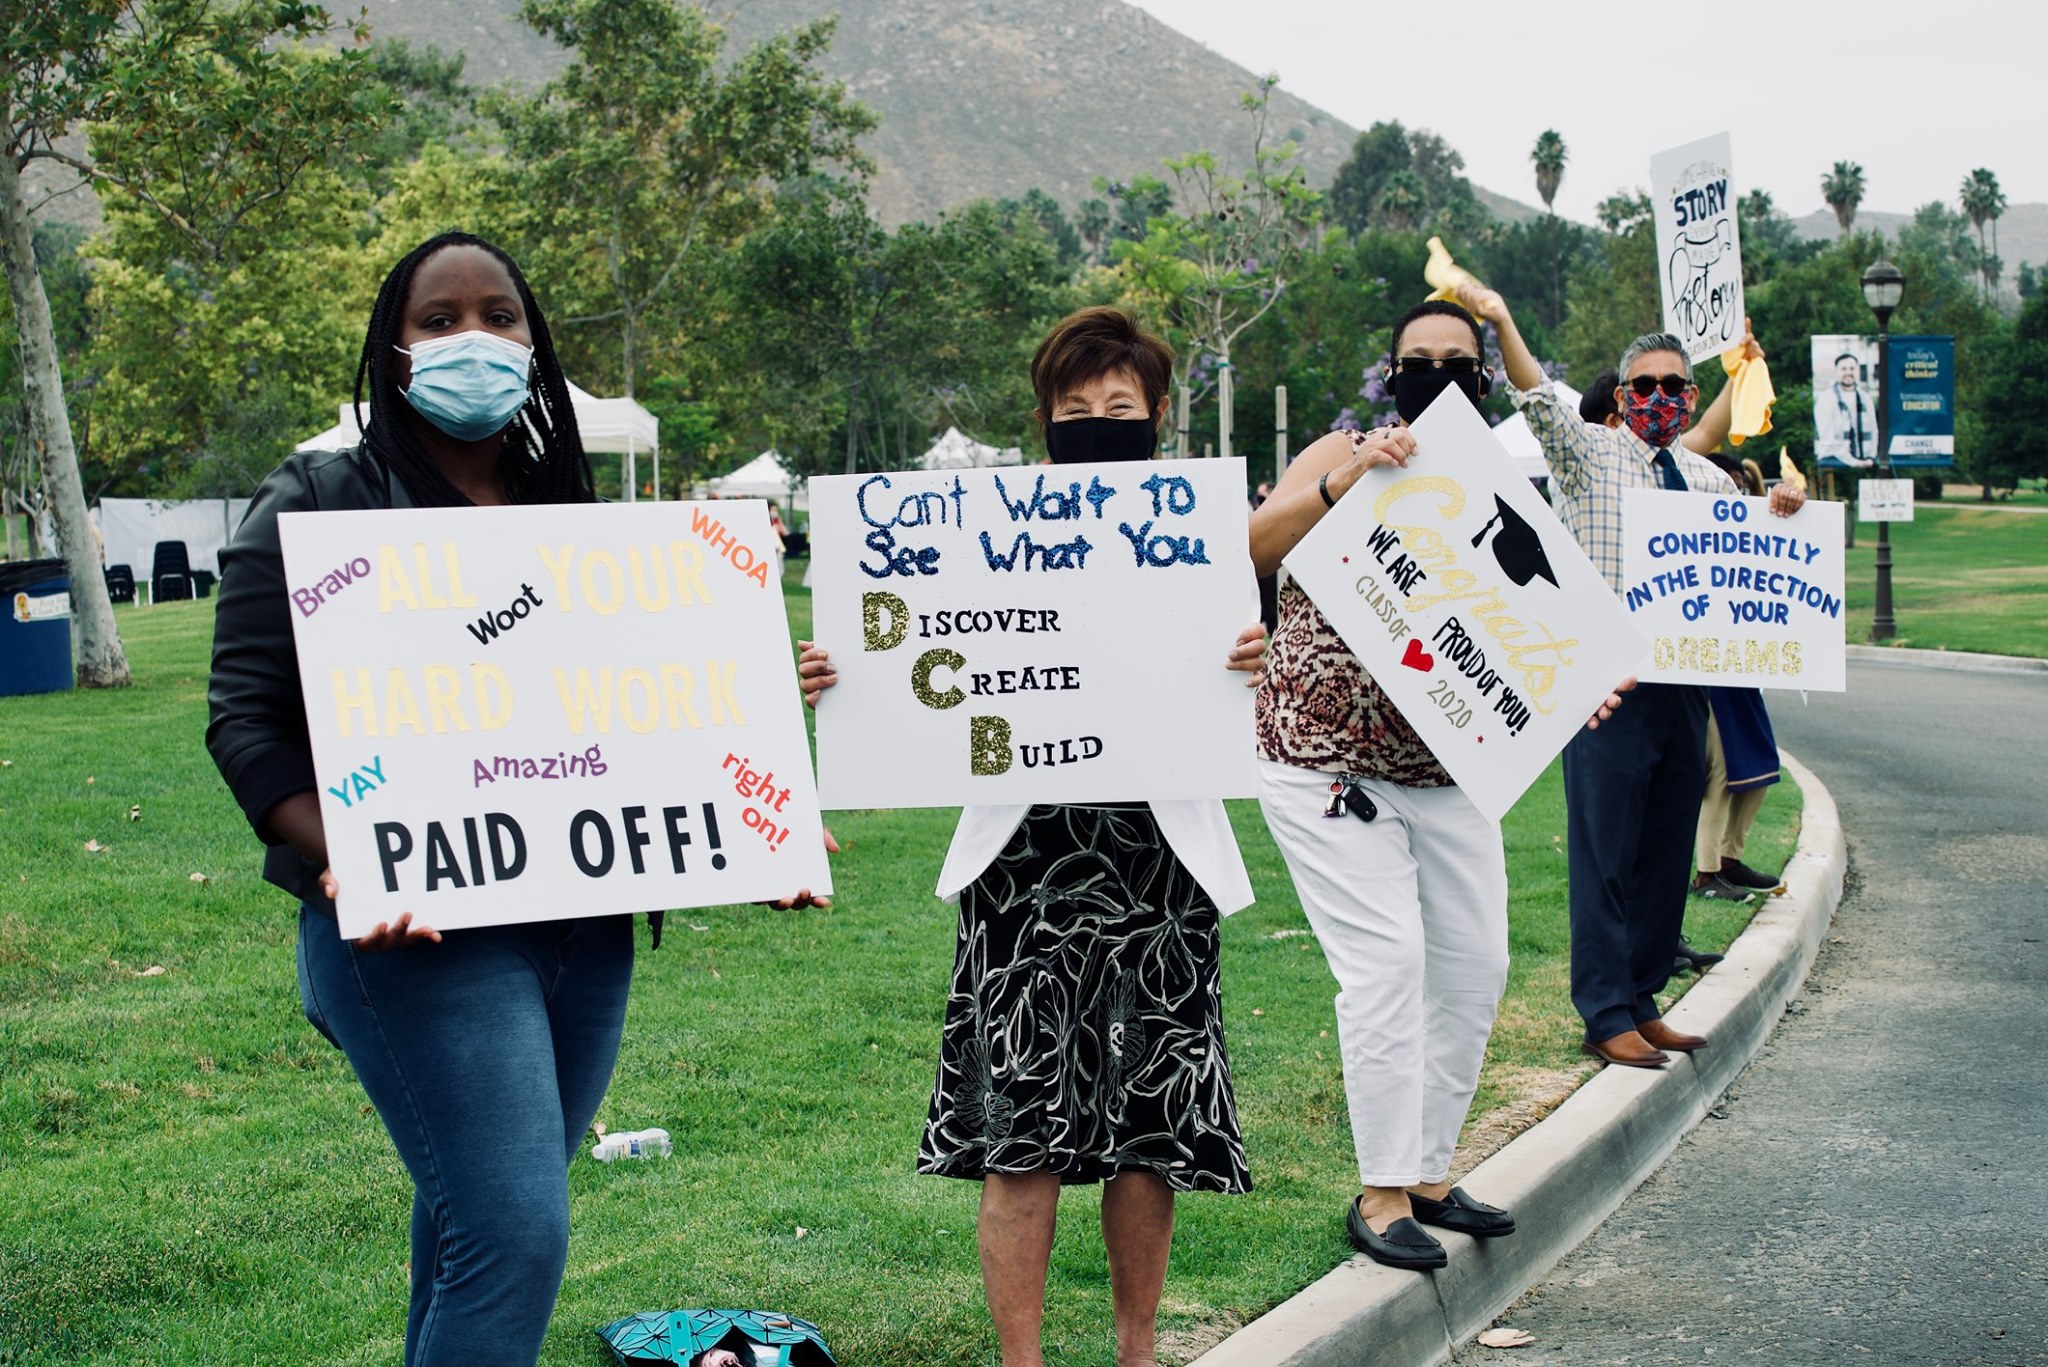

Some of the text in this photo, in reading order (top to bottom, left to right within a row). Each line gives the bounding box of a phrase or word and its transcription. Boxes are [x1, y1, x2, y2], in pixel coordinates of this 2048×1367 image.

[1674, 179, 1728, 228] STORY
[1905, 360, 1939, 369] critical
[1905, 369, 1939, 378] thinker
[1903, 401, 1940, 410] EDUCATOR
[1905, 439, 1933, 448] CHANGE
[994, 474, 1116, 521] Wait
[1712, 499, 1748, 523] GO
[691, 507, 768, 588] WHOA
[859, 520, 1211, 579] See What You
[1648, 531, 1821, 565] CONFIDENTLY
[292, 557, 371, 617] Bravo
[379, 540, 715, 616] ALL YOUR
[1372, 475, 1579, 716] Congrats
[1627, 564, 1841, 619] IN THE DIRECTION
[467, 583, 543, 645] Woot
[1367, 524, 1531, 737] WE ARE PROUD OF YOU!
[1682, 593, 1789, 625] OF YOUR
[1356, 576, 1474, 728] CLASS OF 2020
[1654, 637, 1802, 676] DREAMS
[332, 659, 745, 737] HARD WORK
[328, 755, 386, 808] YAY
[472, 744, 608, 788] Amazing
[722, 754, 790, 813] right
[374, 802, 726, 892] PAID OFF!
[742, 807, 790, 853] on!
